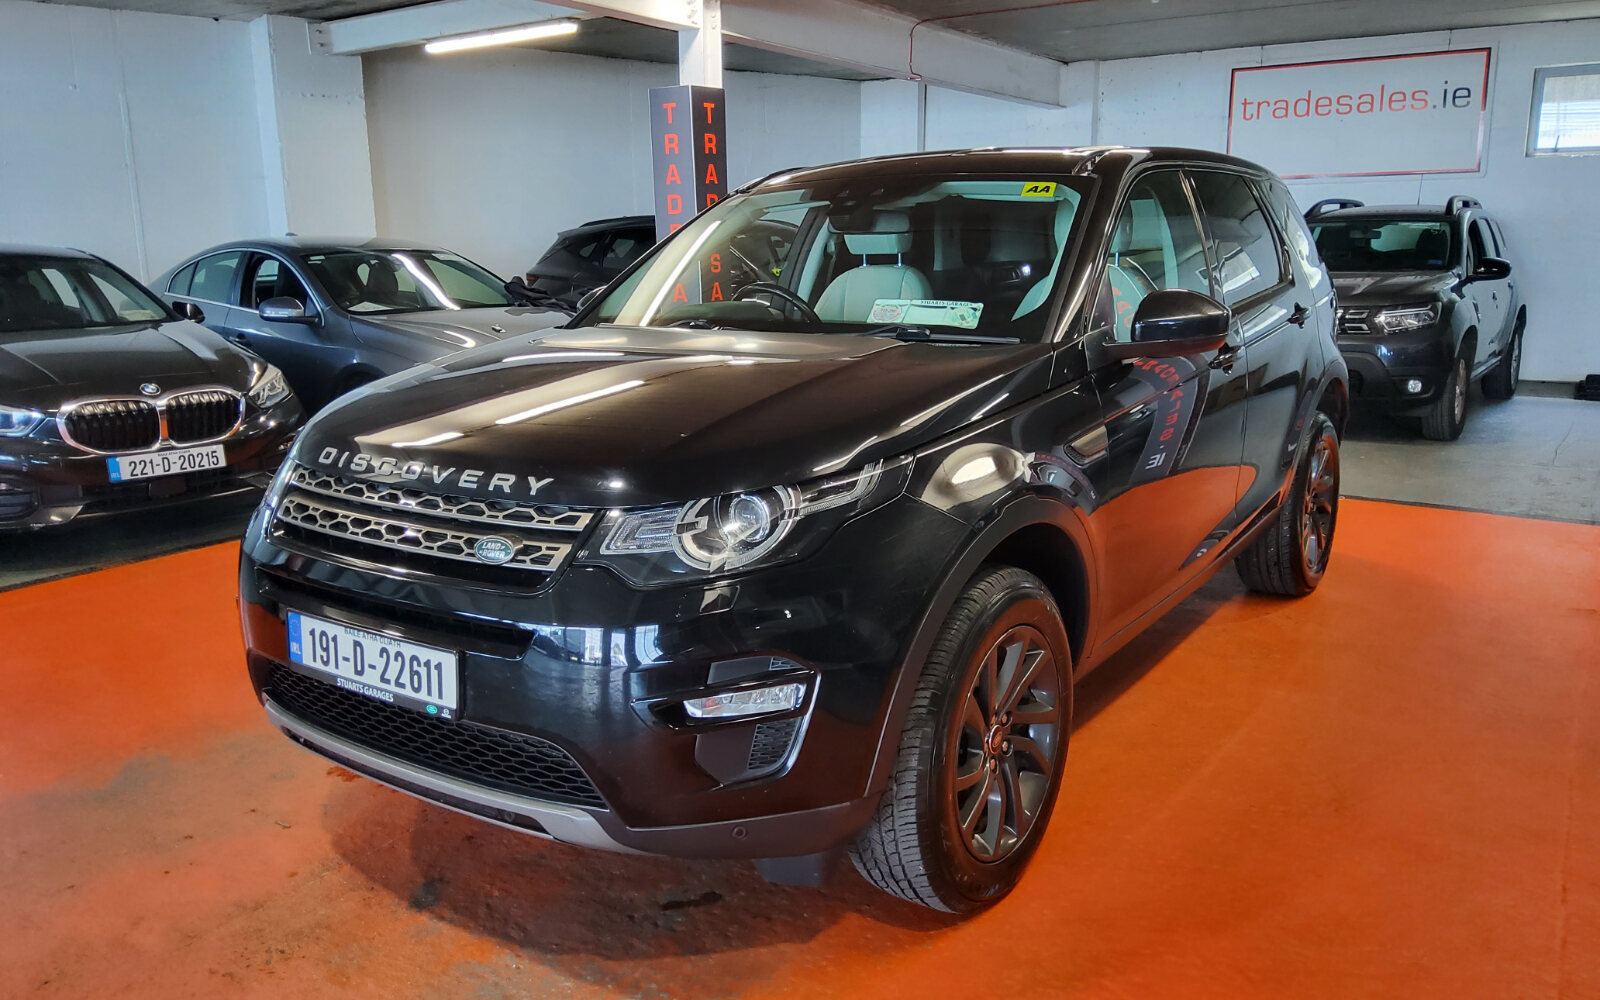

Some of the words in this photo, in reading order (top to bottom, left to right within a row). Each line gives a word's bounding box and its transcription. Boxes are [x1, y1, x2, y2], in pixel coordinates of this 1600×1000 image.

[1241, 80, 1472, 121] tradesales.ie
[1025, 185, 1051, 194] AA
[128, 450, 219, 478] 221-D-20215
[318, 446, 554, 496] DISCOVERY
[481, 541, 502, 550] LAND
[481, 549, 506, 559] ROVER
[290, 641, 302, 655] IRL
[309, 627, 444, 701] 191-D-22611
[336, 677, 364, 693] STUARTS
[364, 686, 394, 702] GARAGES
